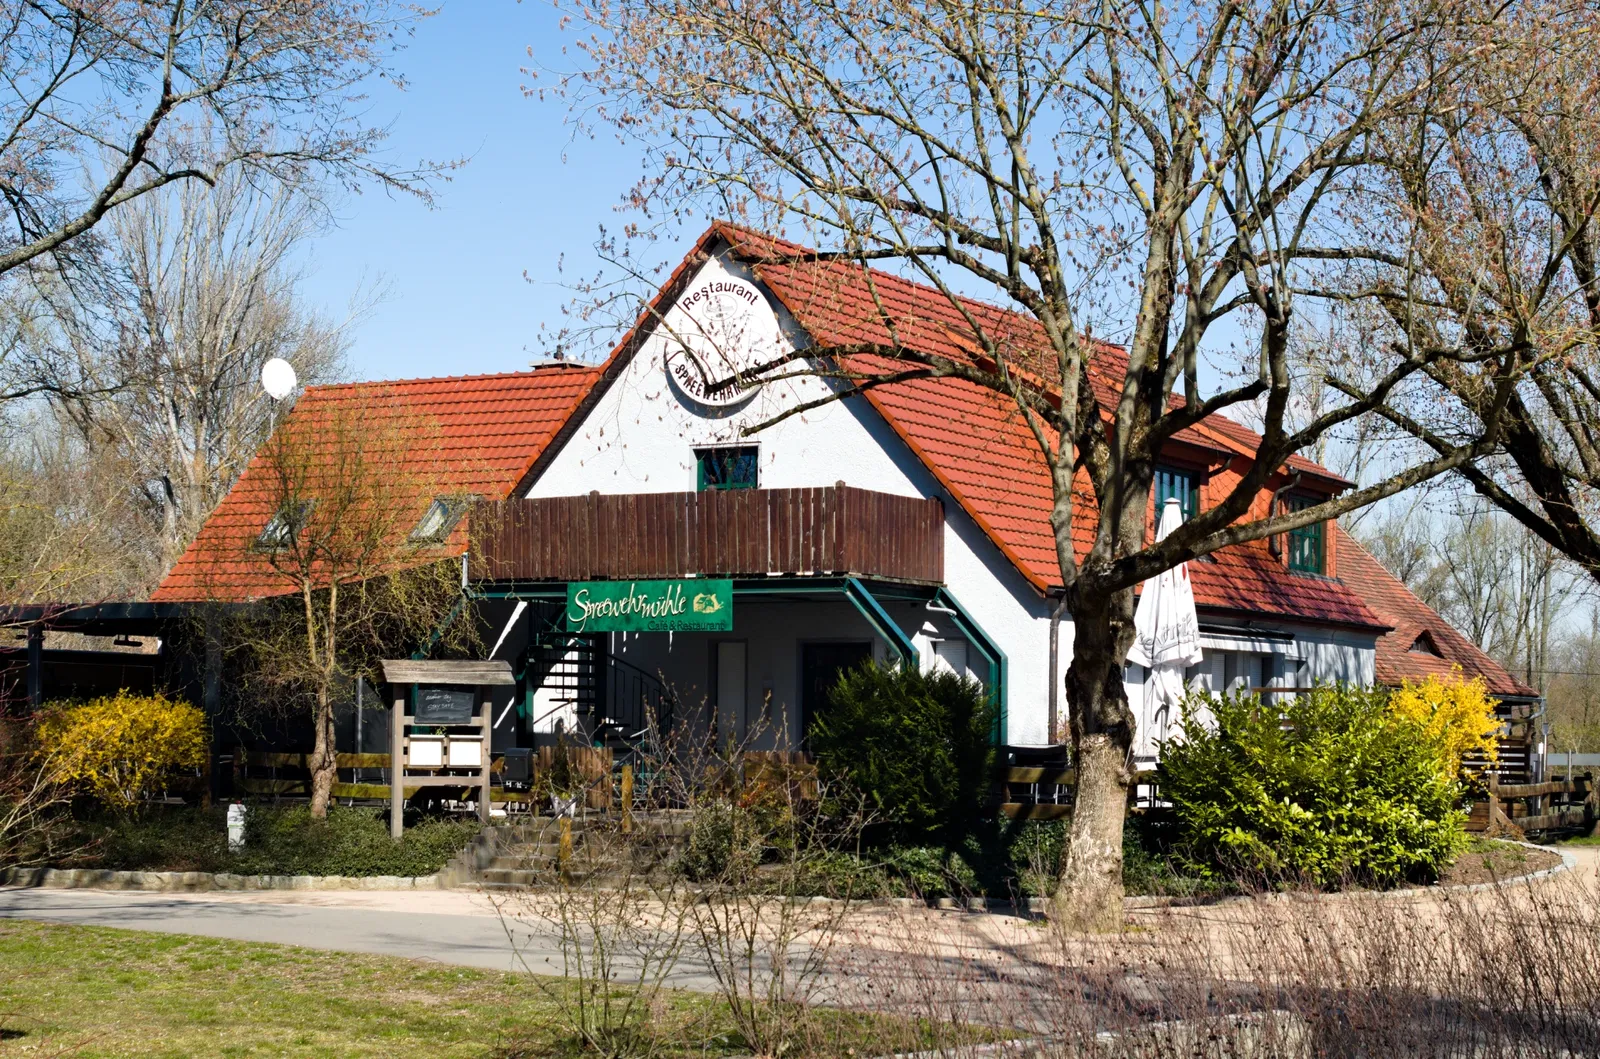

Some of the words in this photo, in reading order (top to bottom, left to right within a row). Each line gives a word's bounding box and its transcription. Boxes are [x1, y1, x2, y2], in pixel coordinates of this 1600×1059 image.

[683, 281, 759, 311] Restaurant
[568, 583, 687, 632] Spreewehrmühle
[648, 620, 668, 631] Café
[669, 620, 676, 631] &
[677, 620, 725, 631] Restaurant
